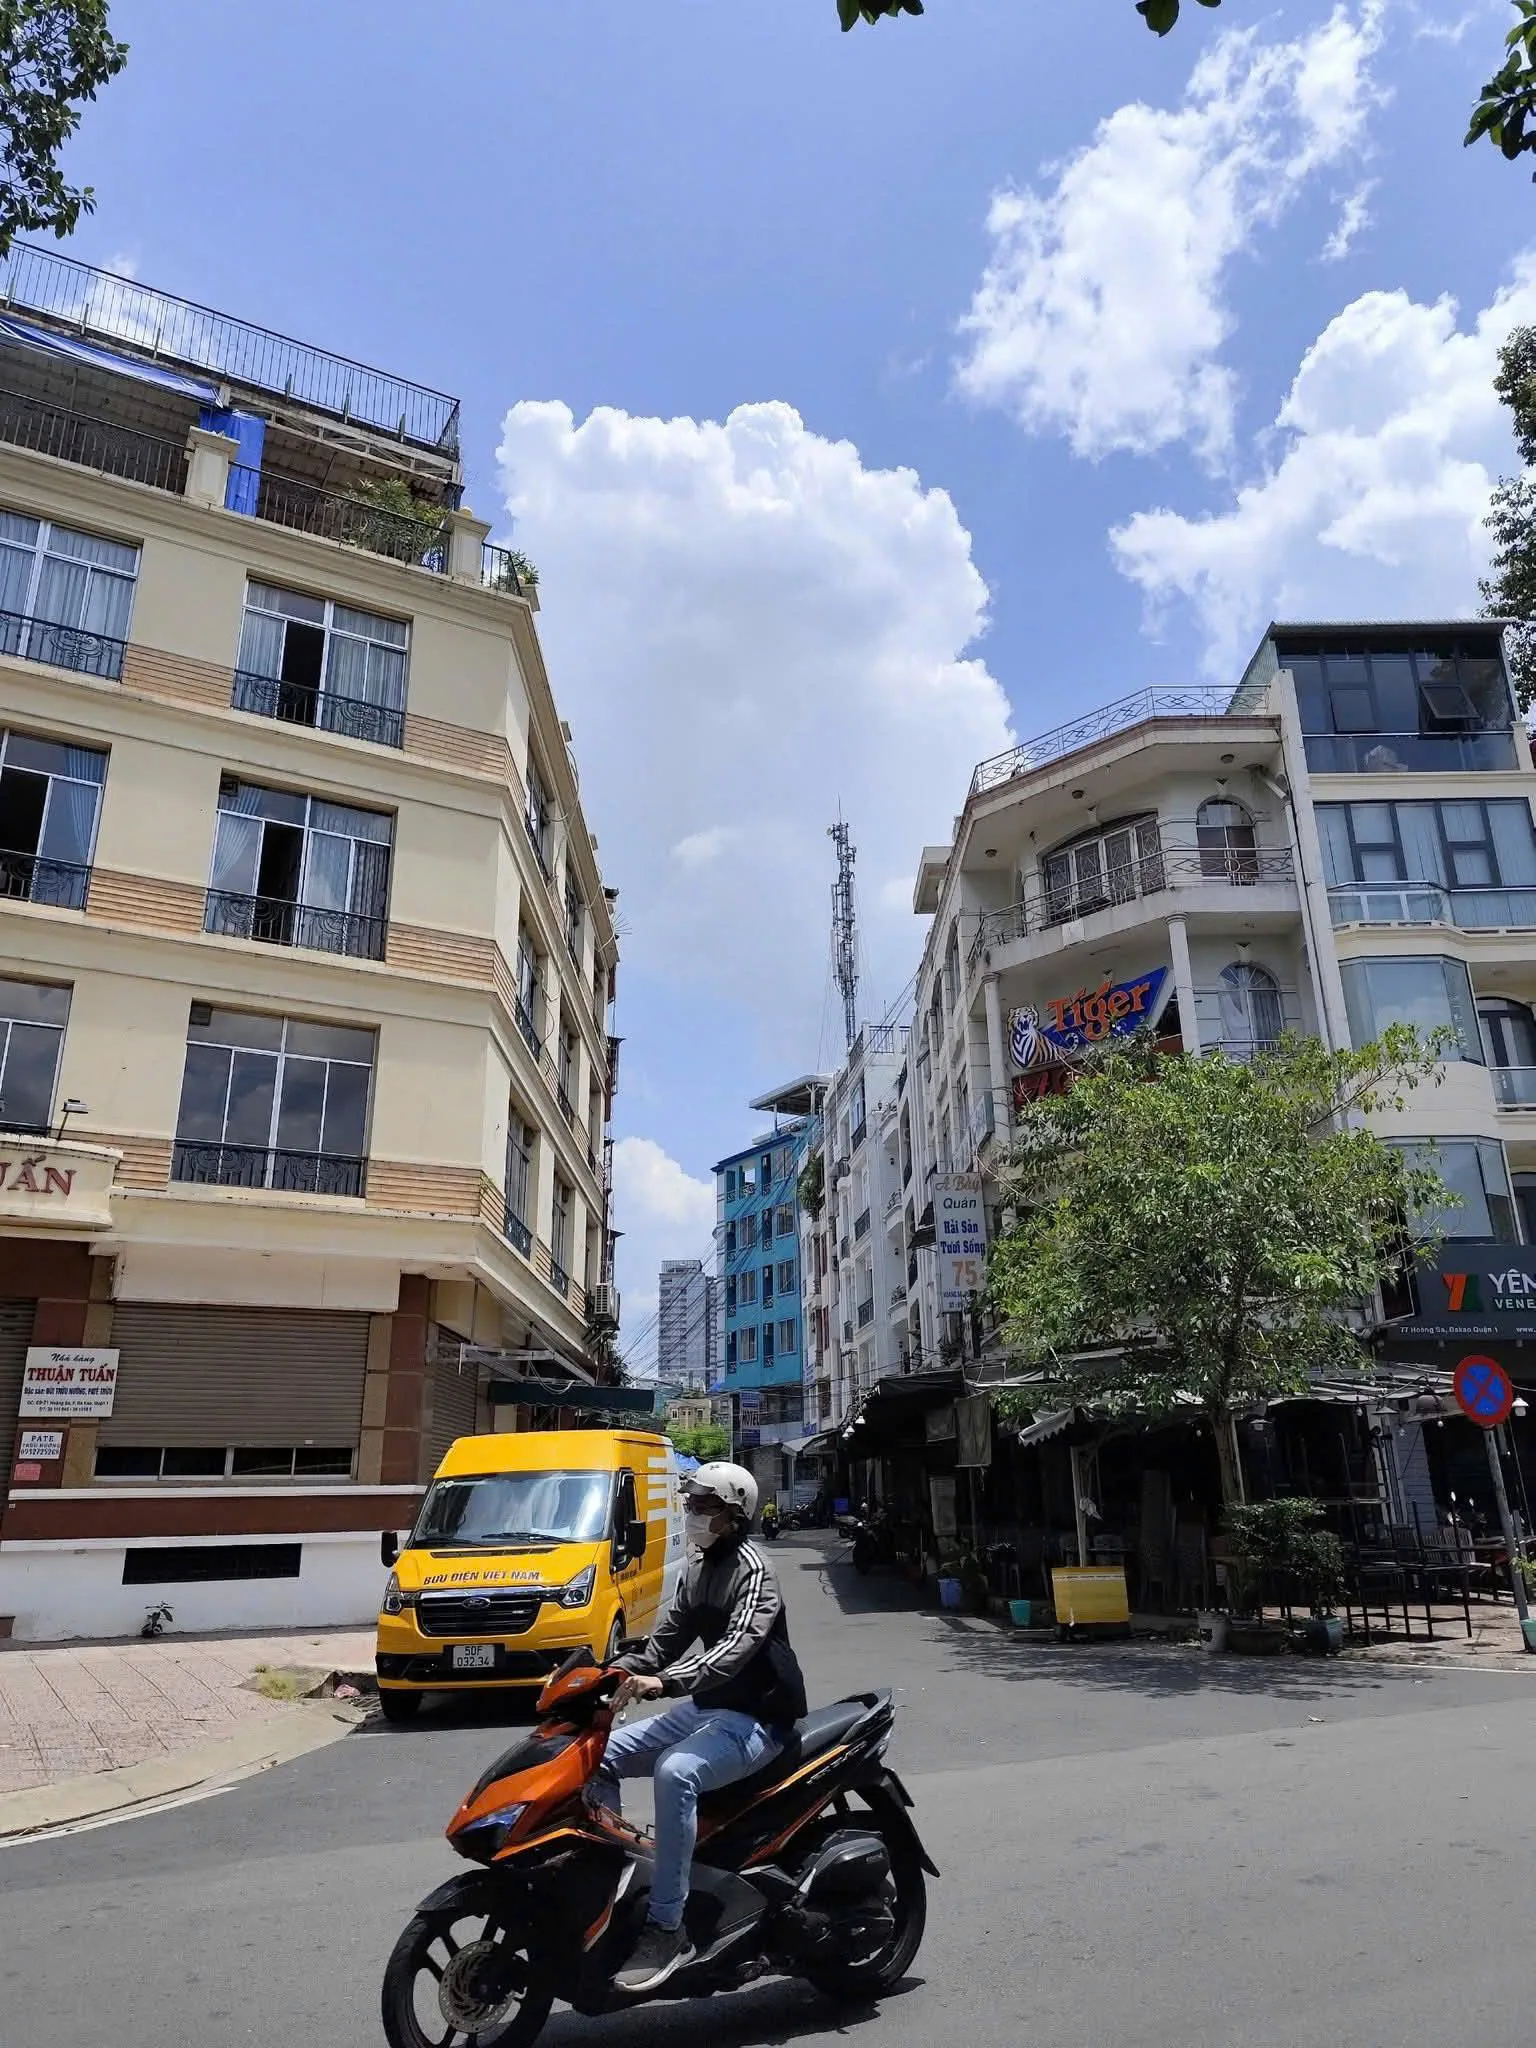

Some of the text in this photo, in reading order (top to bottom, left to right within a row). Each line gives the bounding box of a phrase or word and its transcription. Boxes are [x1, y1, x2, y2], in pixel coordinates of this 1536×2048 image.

[1047, 980, 1151, 1041] Tiger
[943, 1196, 977, 1209] Quán
[943, 1218, 979, 1234] Hải Sản
[951, 1260, 978, 1287] 75
[1400, 1326, 1409, 1334] 77
[51, 1352, 70, 1361] Nhà
[27, 1363, 116, 1385] THUẬN TUẤN
[511, 1570, 541, 1581] NAM
[464, 1645, 483, 1656] 50F
[456, 1656, 490, 1667] 032.34
